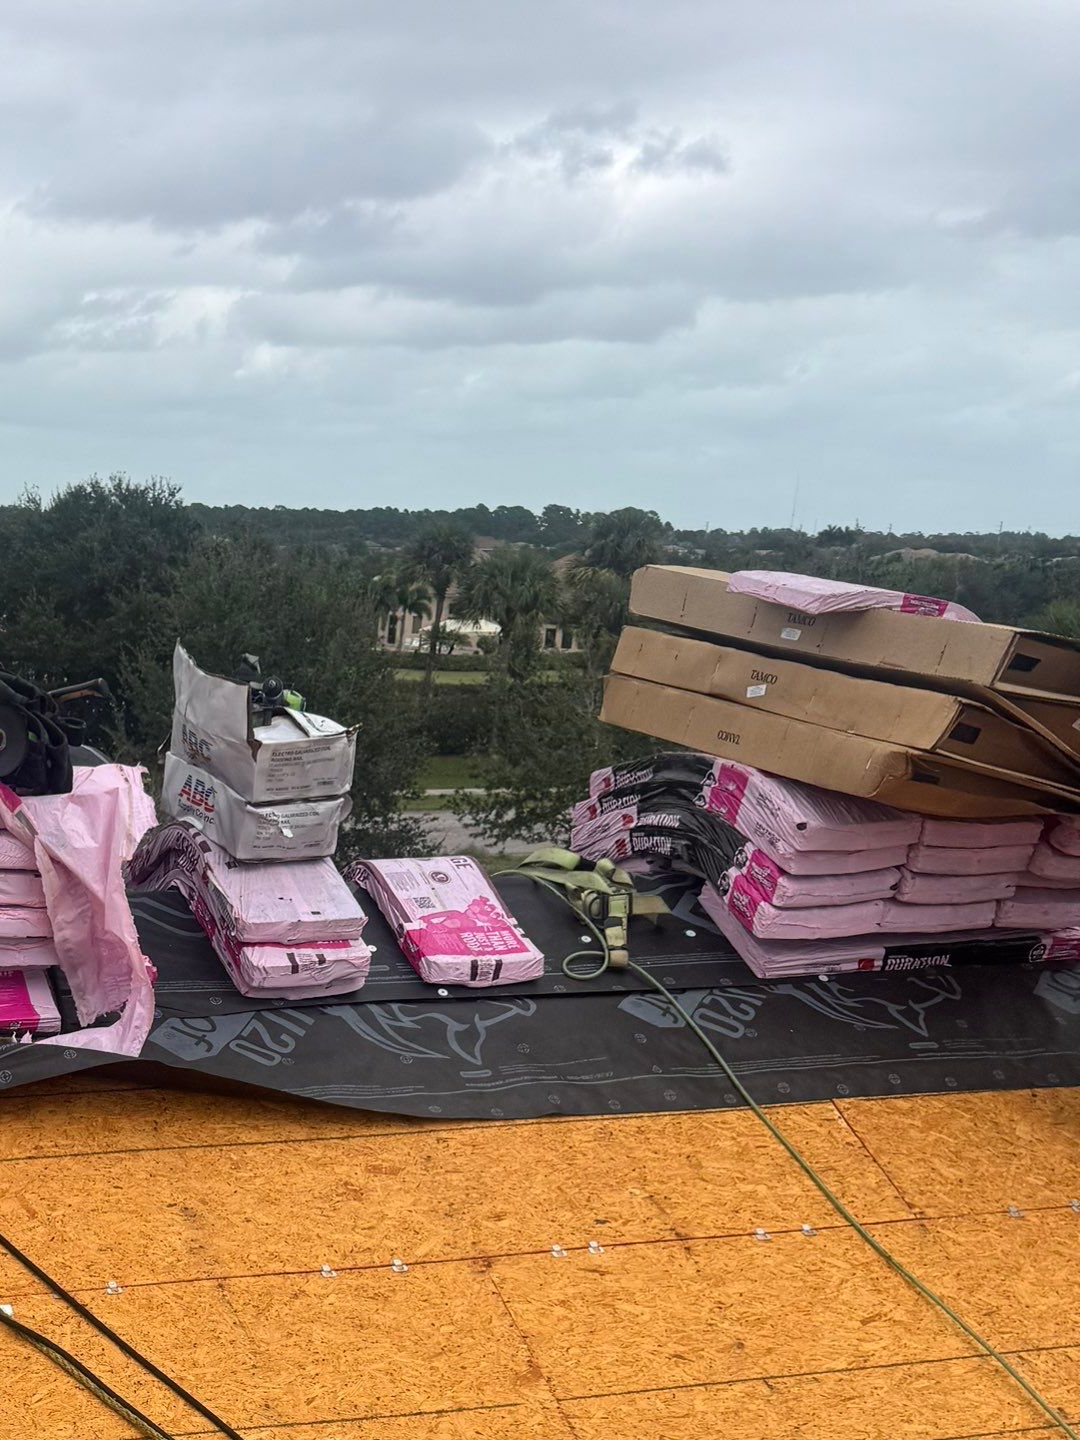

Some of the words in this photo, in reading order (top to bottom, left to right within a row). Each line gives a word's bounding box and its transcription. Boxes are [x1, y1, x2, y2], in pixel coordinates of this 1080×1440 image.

[787, 612, 816, 626] TAMCO
[750, 669, 778, 685] TAMCO
[178, 774, 216, 813] ABC
[885, 954, 952, 971] DURATION
